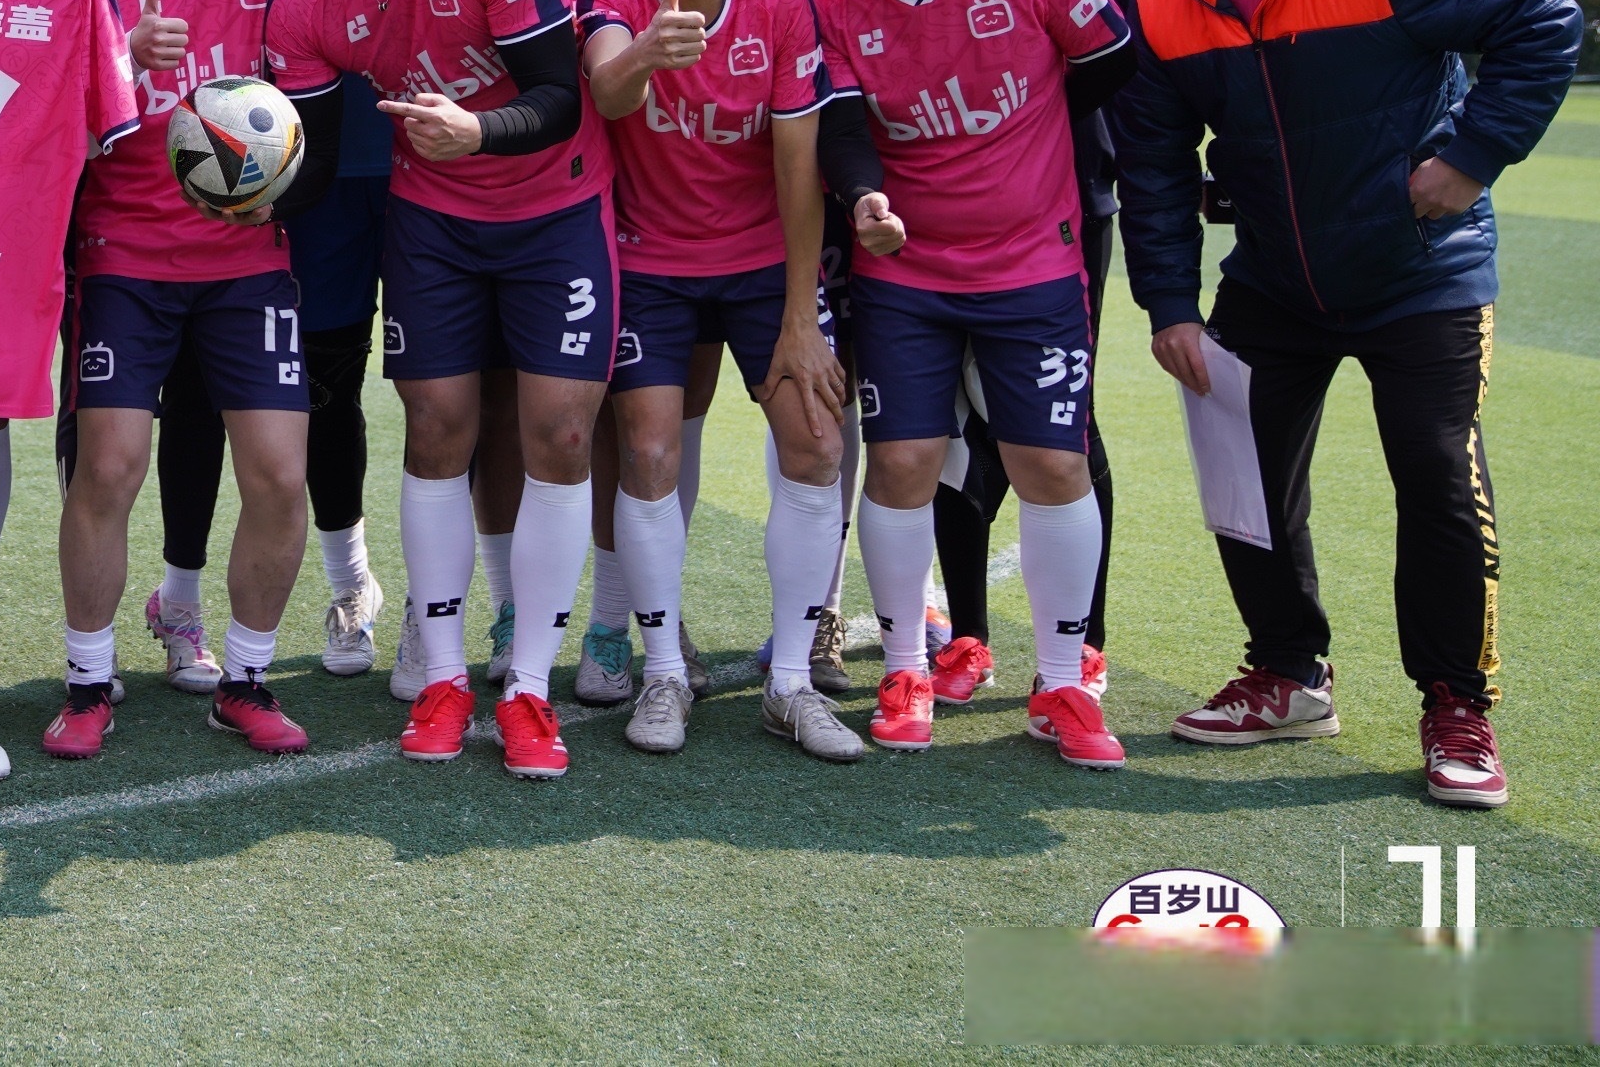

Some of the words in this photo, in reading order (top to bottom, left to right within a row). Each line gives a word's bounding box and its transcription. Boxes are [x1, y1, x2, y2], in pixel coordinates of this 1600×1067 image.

[865, 70, 1028, 142] bilibili
[561, 277, 597, 322] 3
[1035, 346, 1089, 394] 33
[1486, 592, 1495, 639] EXTREME
